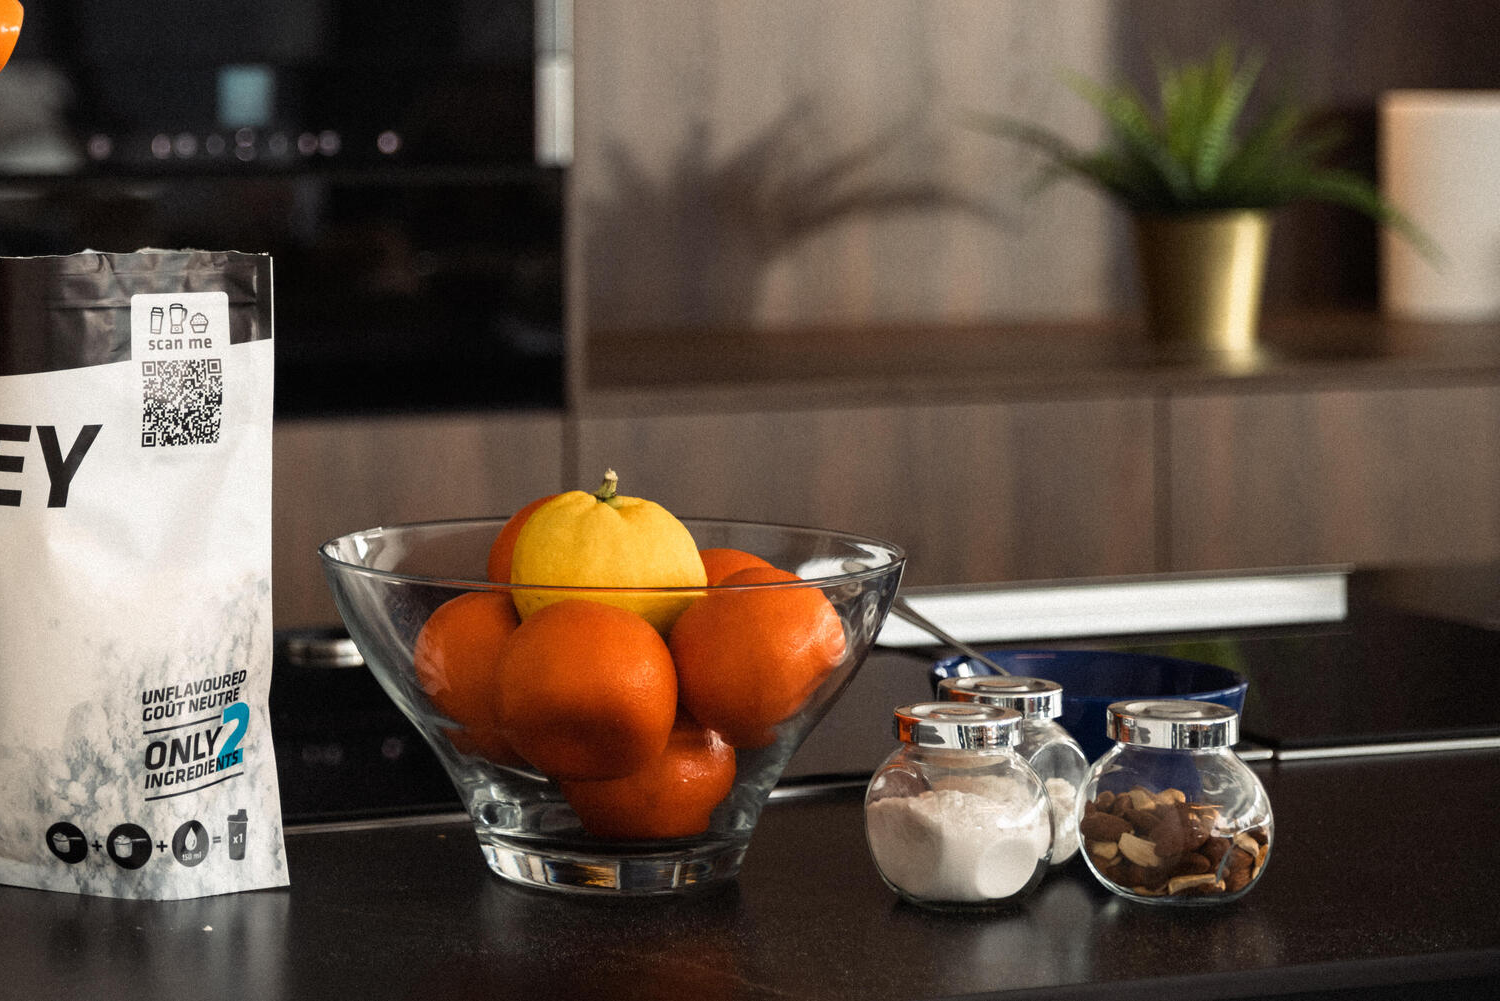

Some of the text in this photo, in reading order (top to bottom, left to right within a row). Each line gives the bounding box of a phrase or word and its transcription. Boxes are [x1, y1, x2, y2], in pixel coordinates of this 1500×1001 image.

[148, 337, 213, 351] scan me
[142, 669, 247, 706] UNFLAVOURED
[142, 687, 240, 722] GOÛT NEUTRE
[144, 701, 250, 772] ONLY 2
[144, 749, 239, 790] INGREDIENTS
[232, 832, 244, 845] x1
